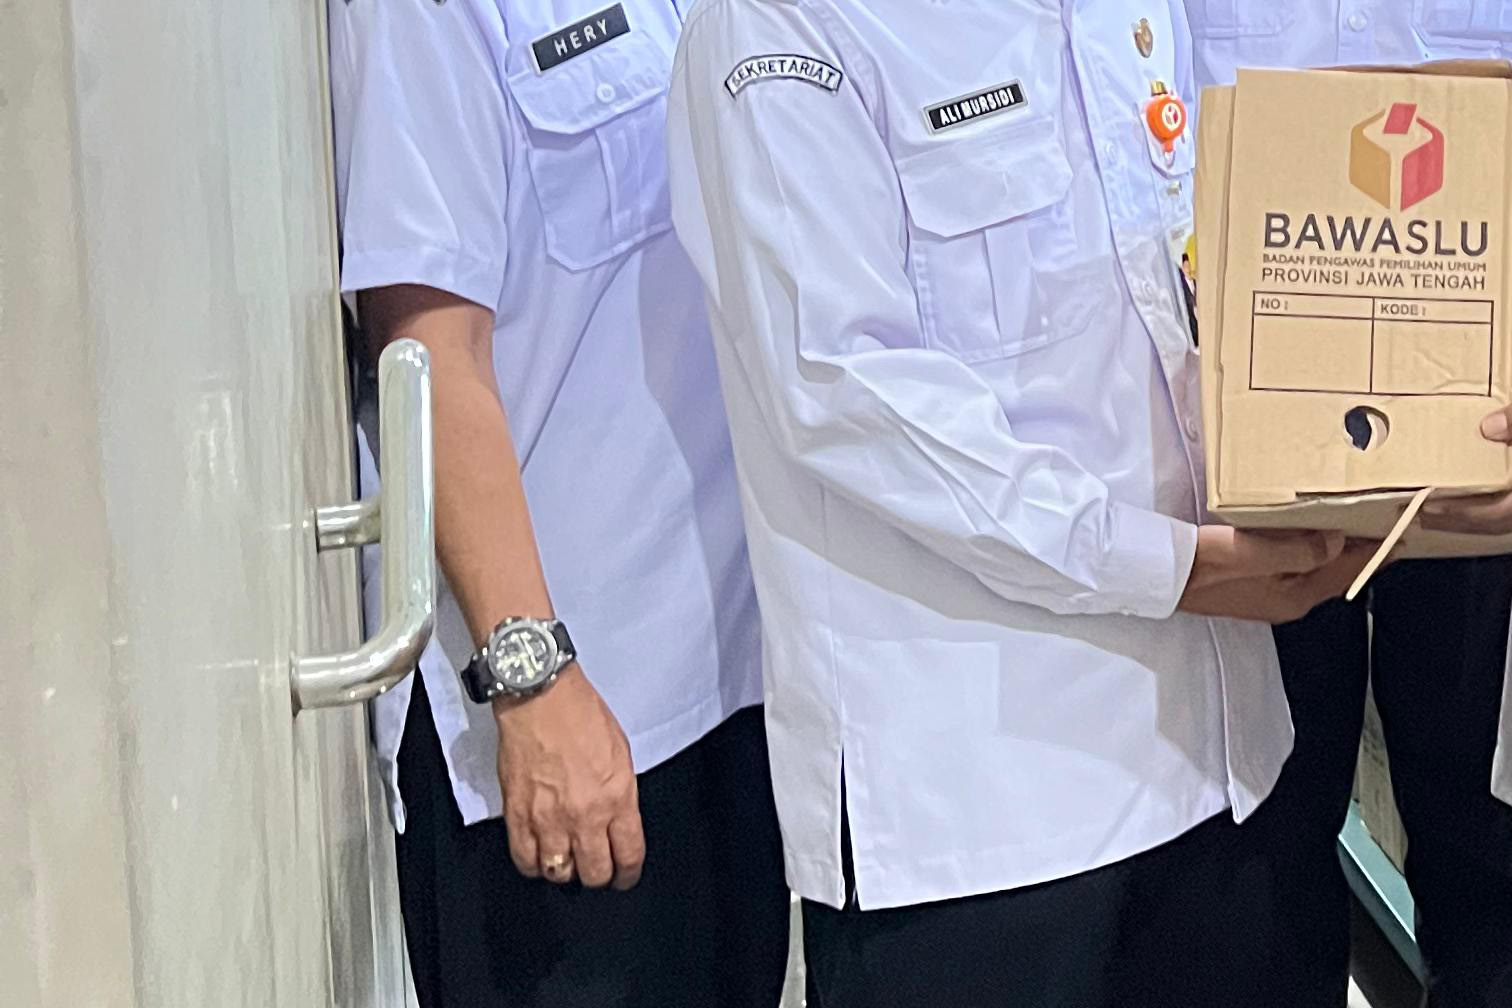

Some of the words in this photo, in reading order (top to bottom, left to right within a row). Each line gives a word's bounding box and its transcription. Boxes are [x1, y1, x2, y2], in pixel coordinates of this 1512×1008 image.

[554, 18, 609, 57] HERY
[731, 58, 835, 86] SEKRETARIAT
[1263, 212, 1489, 257] BAWASLU
[1262, 253, 1305, 266] BADAN
[1308, 255, 1375, 269] PENGAWAS
[1379, 258, 1444, 271] PEMILIHAN
[1447, 261, 1487, 273] UMUM
[1261, 267, 1349, 286] PROVINSI
[1356, 271, 1404, 288] JAWA
[1410, 273, 1486, 291] TENGAH
